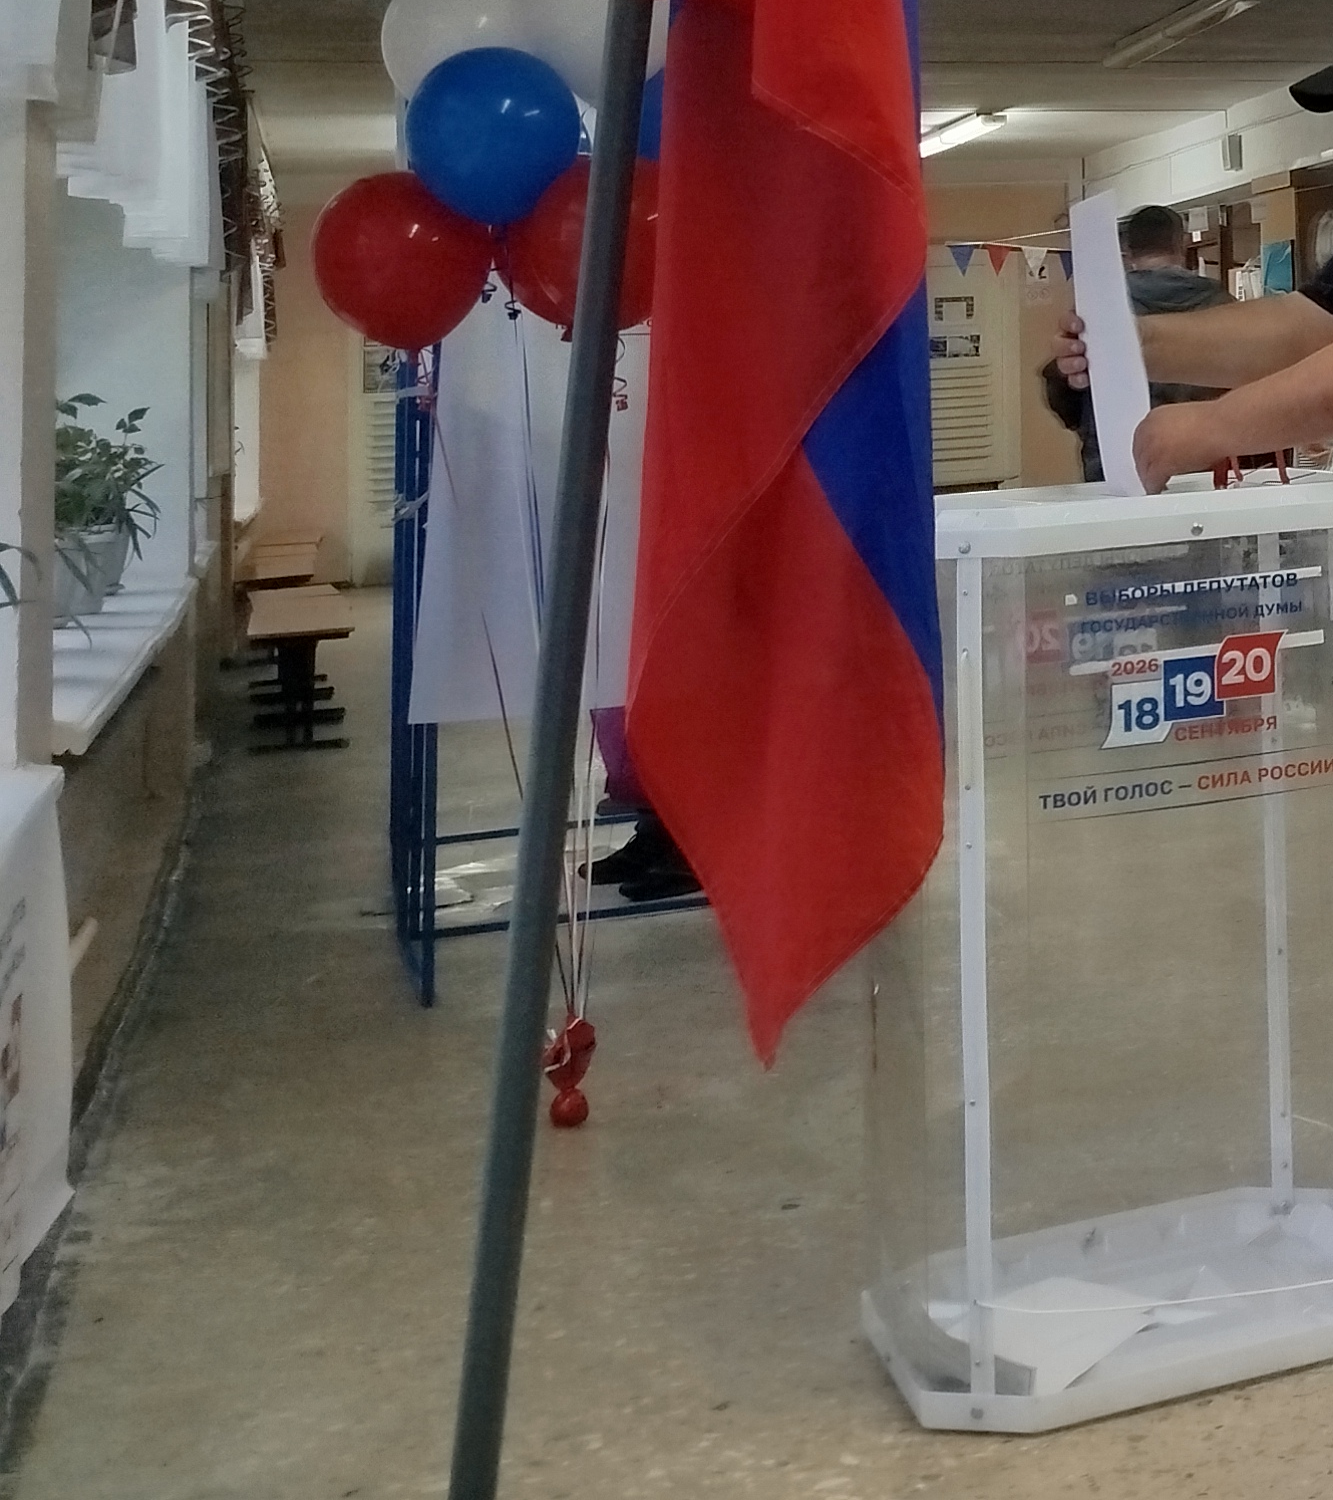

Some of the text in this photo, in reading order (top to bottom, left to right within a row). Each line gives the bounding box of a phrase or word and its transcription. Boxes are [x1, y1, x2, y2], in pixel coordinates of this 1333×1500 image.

[1085, 572, 1298, 606] ВЫБОРЫ ДЕПУТАТОВ
[1254, 601, 1303, 619] ДУМЫ
[1111, 658, 1159, 677] 2026
[1117, 697, 1160, 733] 18
[1169, 671, 1212, 708] 19
[1221, 648, 1272, 685] 20
[1174, 715, 1277, 742] СЕНТЯБРЯ
[1039, 786, 1097, 810] ТВОЙ
[1103, 779, 1174, 803] ГОЛОС
[1197, 769, 1253, 791] СИЛА
